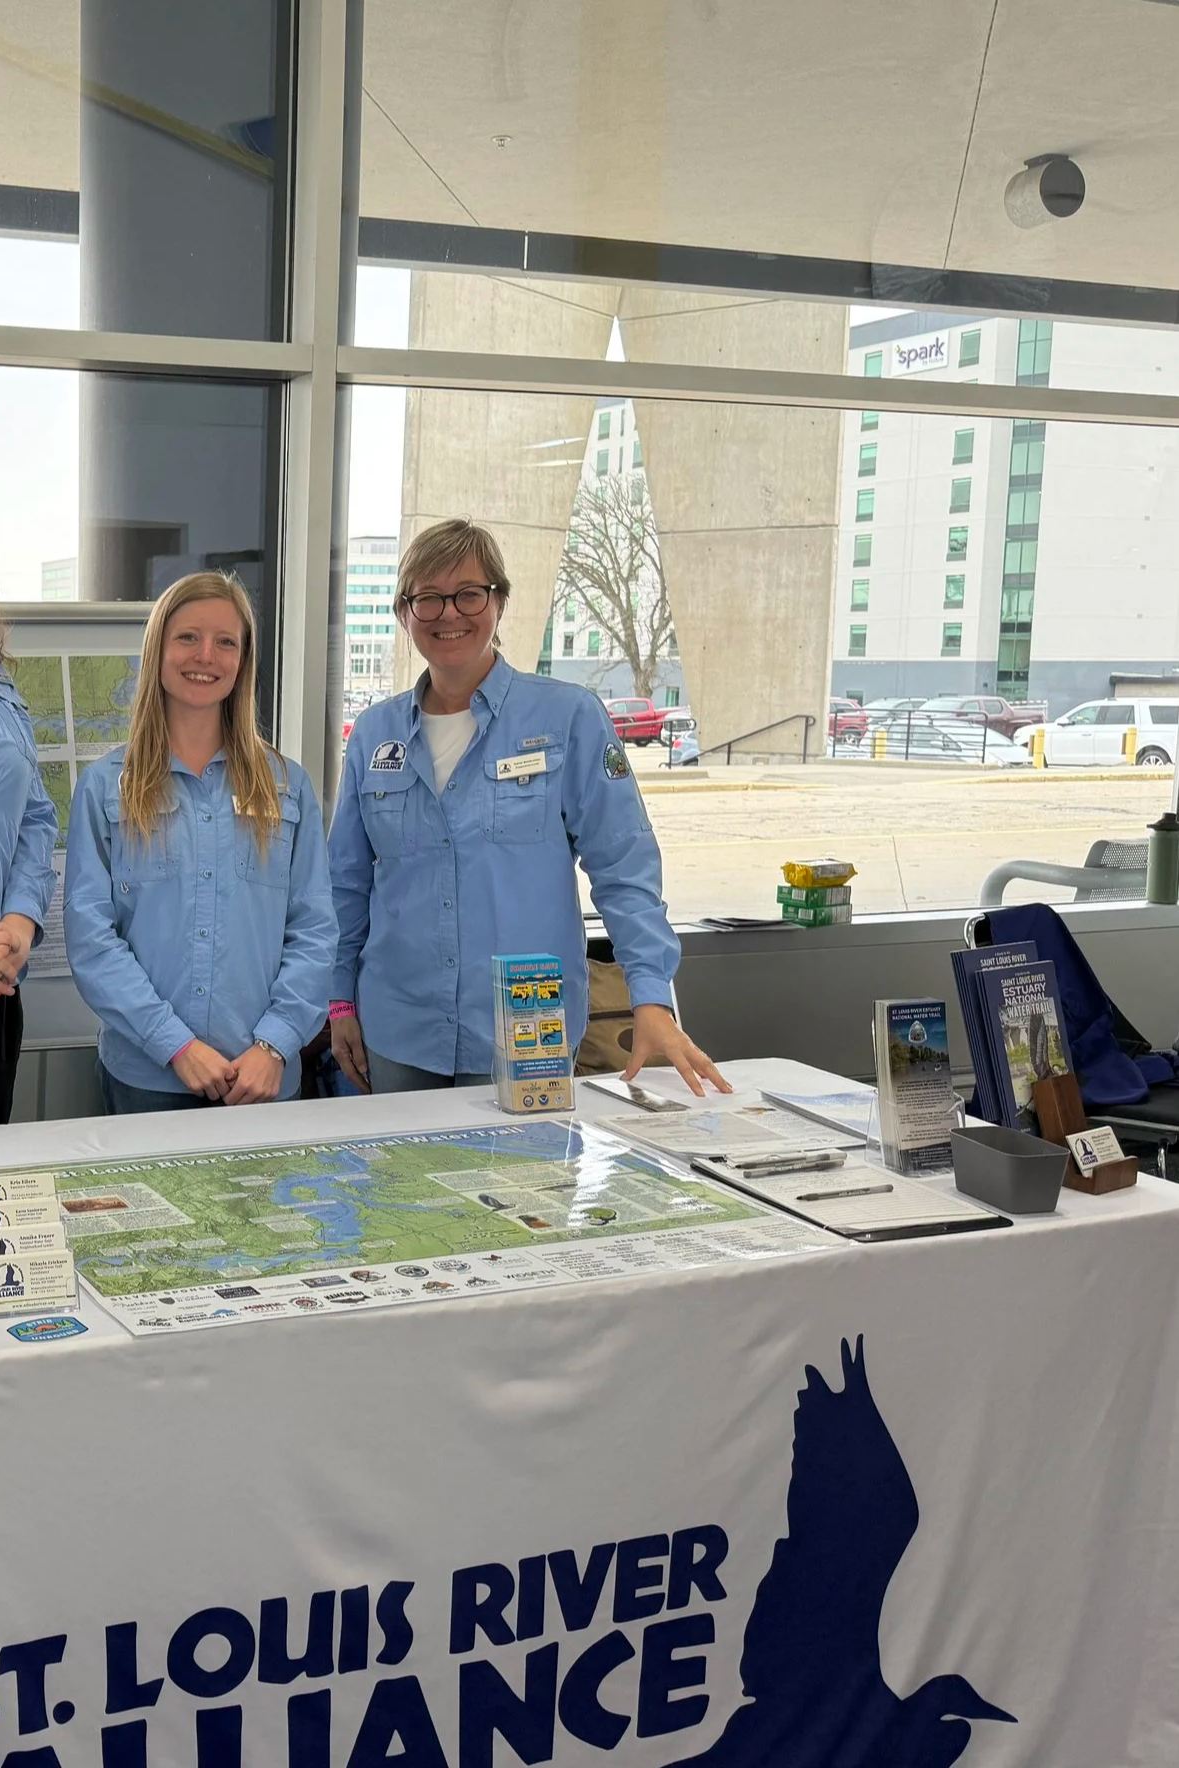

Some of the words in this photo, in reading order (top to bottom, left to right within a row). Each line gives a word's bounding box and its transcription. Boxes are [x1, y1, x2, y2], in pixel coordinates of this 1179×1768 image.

[898, 336, 945, 369] spark
[980, 957, 996, 967] SAINT
[996, 955, 1012, 965] LOUIS
[1012, 953, 1027, 962] RIVER
[1001, 977, 1016, 988] SAINT
[1016, 975, 1032, 985] LOUIS
[1031, 973, 1046, 983] RIVER
[1002, 982, 1047, 998] ESTUARY
[1004, 992, 1049, 1007] NATIONAL
[1007, 1004, 1031, 1019] WATER
[1031, 1001, 1051, 1015] TRAIL
[90, 1162, 154, 1176] Louis
[157, 1156, 218, 1170] River
[221, 1147, 309, 1163] Estuary
[310, 1136, 404, 1154] National
[407, 1132, 471, 1145] Water
[472, 1126, 525, 1138] Trail
[110, 1293, 157, 1302] SILVER
[163, 1283, 232, 1295] SPONSORS
[105, 1580, 415, 1715] LOUIS
[449, 1523, 730, 1655] RIVER
